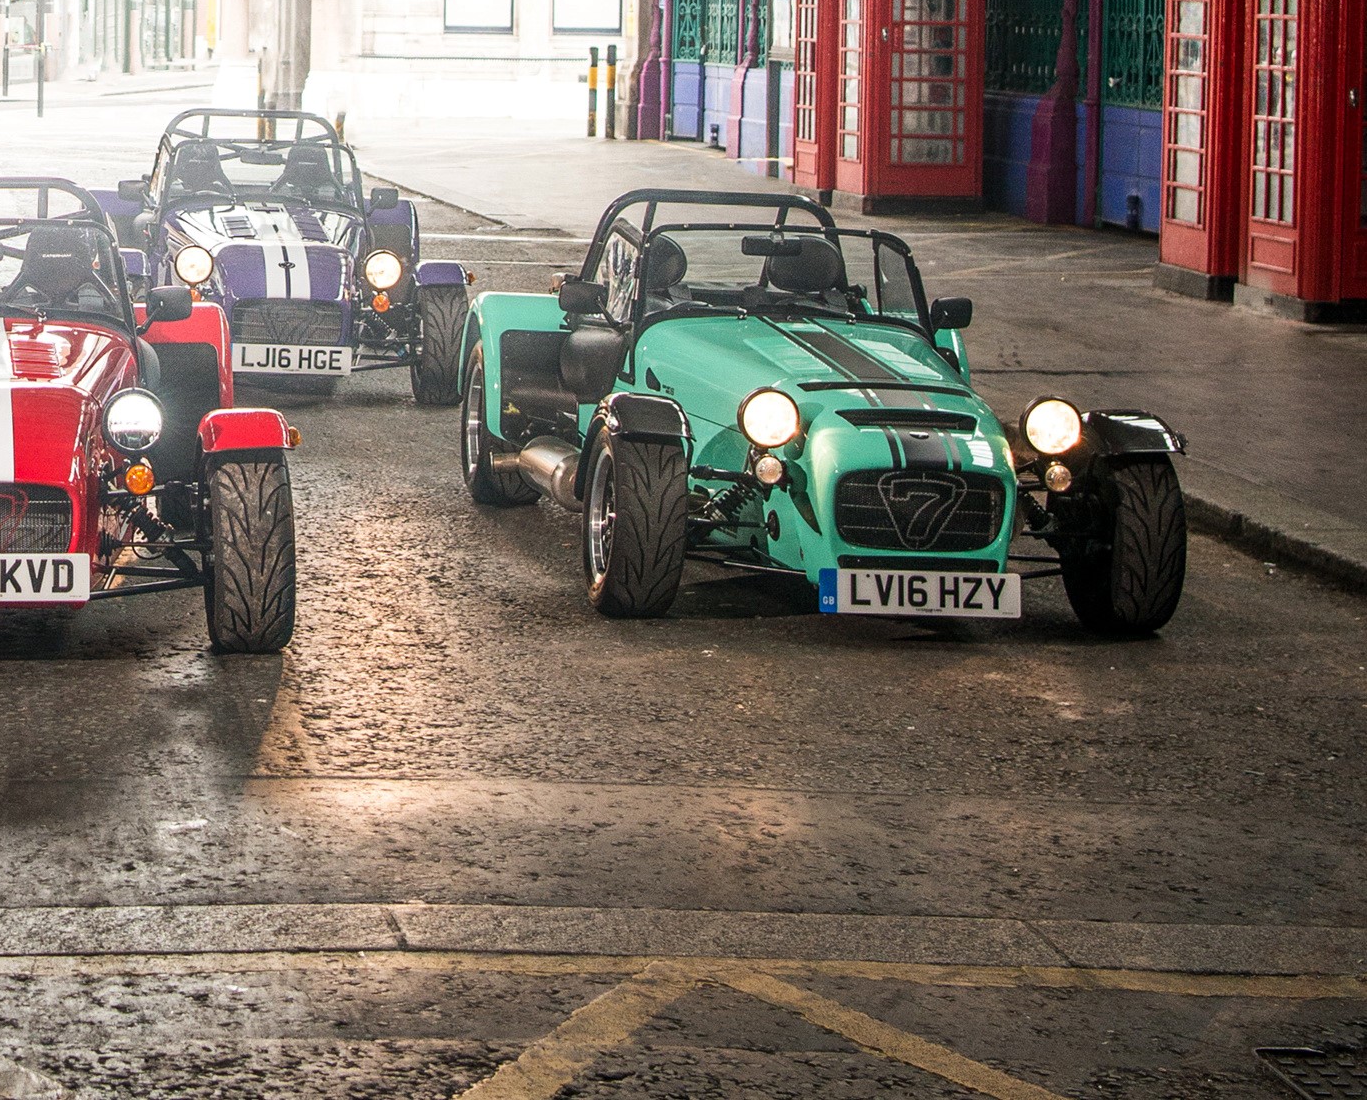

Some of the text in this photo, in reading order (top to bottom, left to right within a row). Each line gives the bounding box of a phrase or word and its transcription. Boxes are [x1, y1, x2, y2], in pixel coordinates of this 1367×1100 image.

[241, 346, 343, 371] LJ16 HGE
[890, 479, 956, 540] 7
[0, 559, 75, 594] KVD
[850, 573, 1007, 610] LV16 HZY
[822, 595, 835, 605] GB
